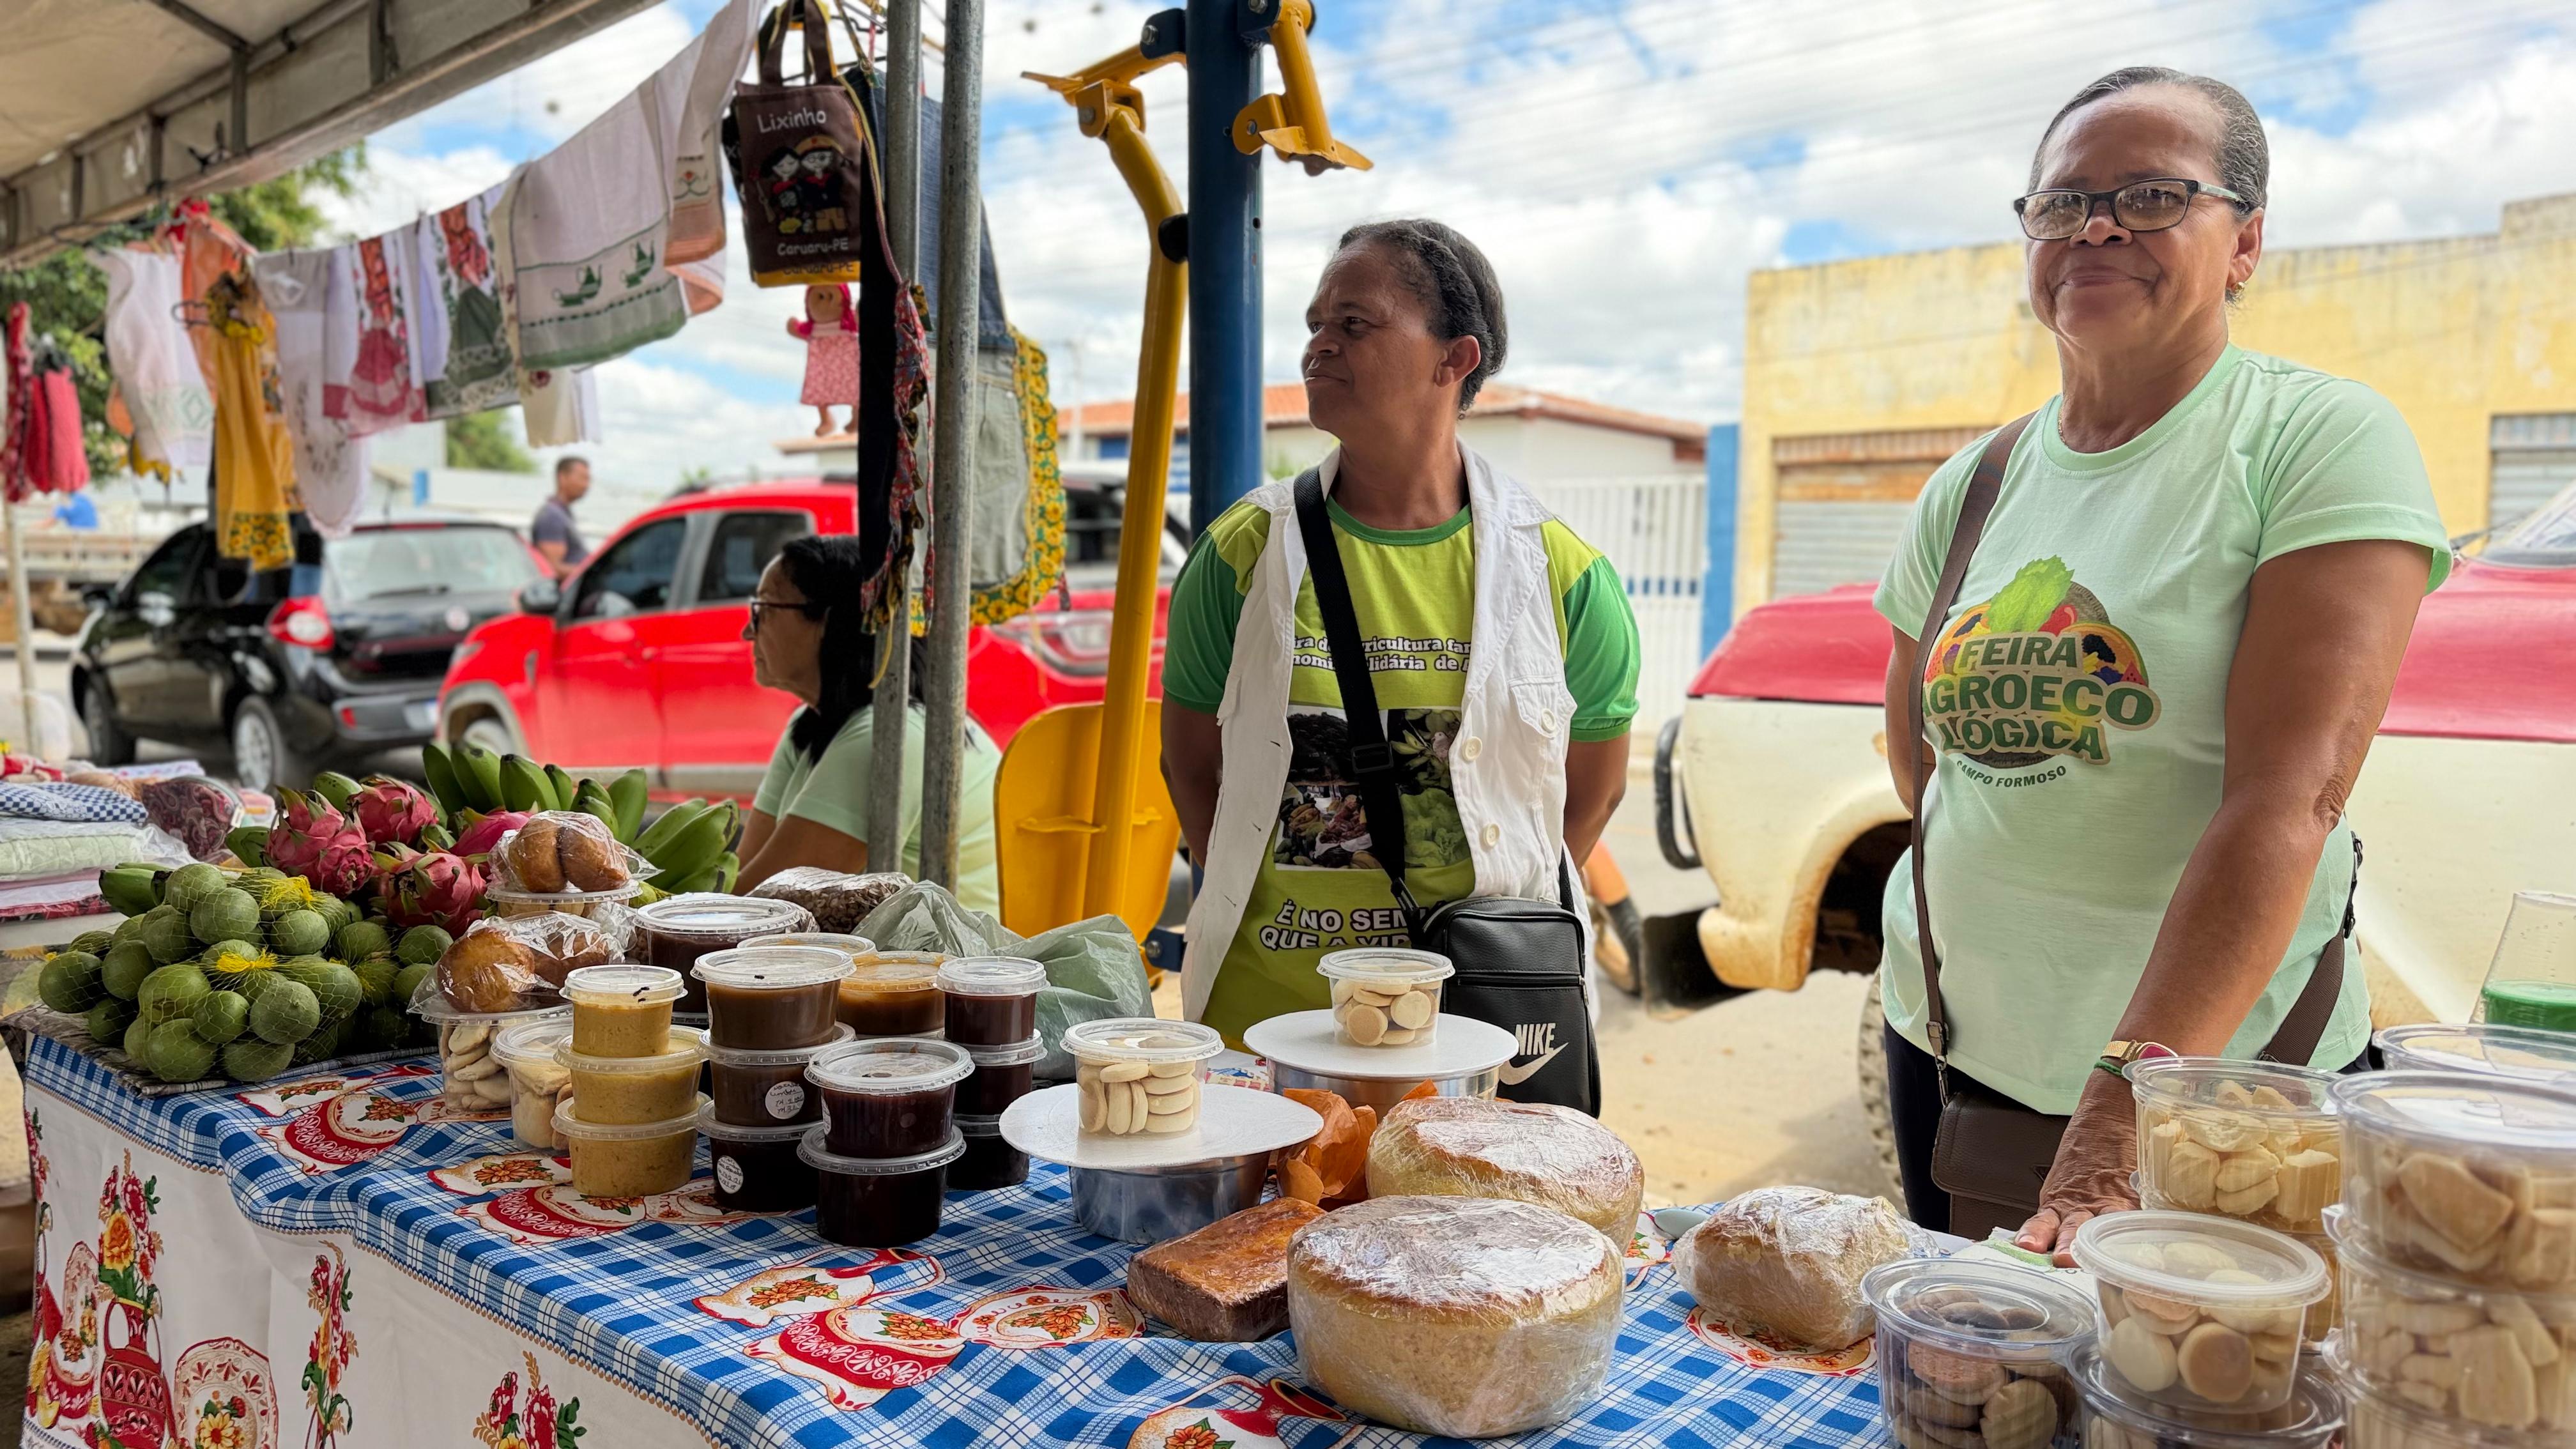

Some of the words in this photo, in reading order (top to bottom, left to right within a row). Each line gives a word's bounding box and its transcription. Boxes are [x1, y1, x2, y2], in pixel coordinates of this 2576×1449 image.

[757, 107, 827, 133] Lixinho
[777, 237, 848, 255] Caruaru-PE
[1361, 636, 1443, 652] ricultura
[1959, 636, 2077, 668] FEIRA
[1367, 654, 1427, 672] lidária
[1435, 654, 1459, 671] de
[1938, 710, 2104, 760] LÓGICA
[1956, 760, 1993, 785] CAMPO
[1995, 765, 2067, 788] FORMOSO
[1275, 898, 1296, 926] É
[1300, 907, 1343, 933] NO
[1260, 925, 1319, 951] QUE
[1515, 1023, 1556, 1055] NIKE
